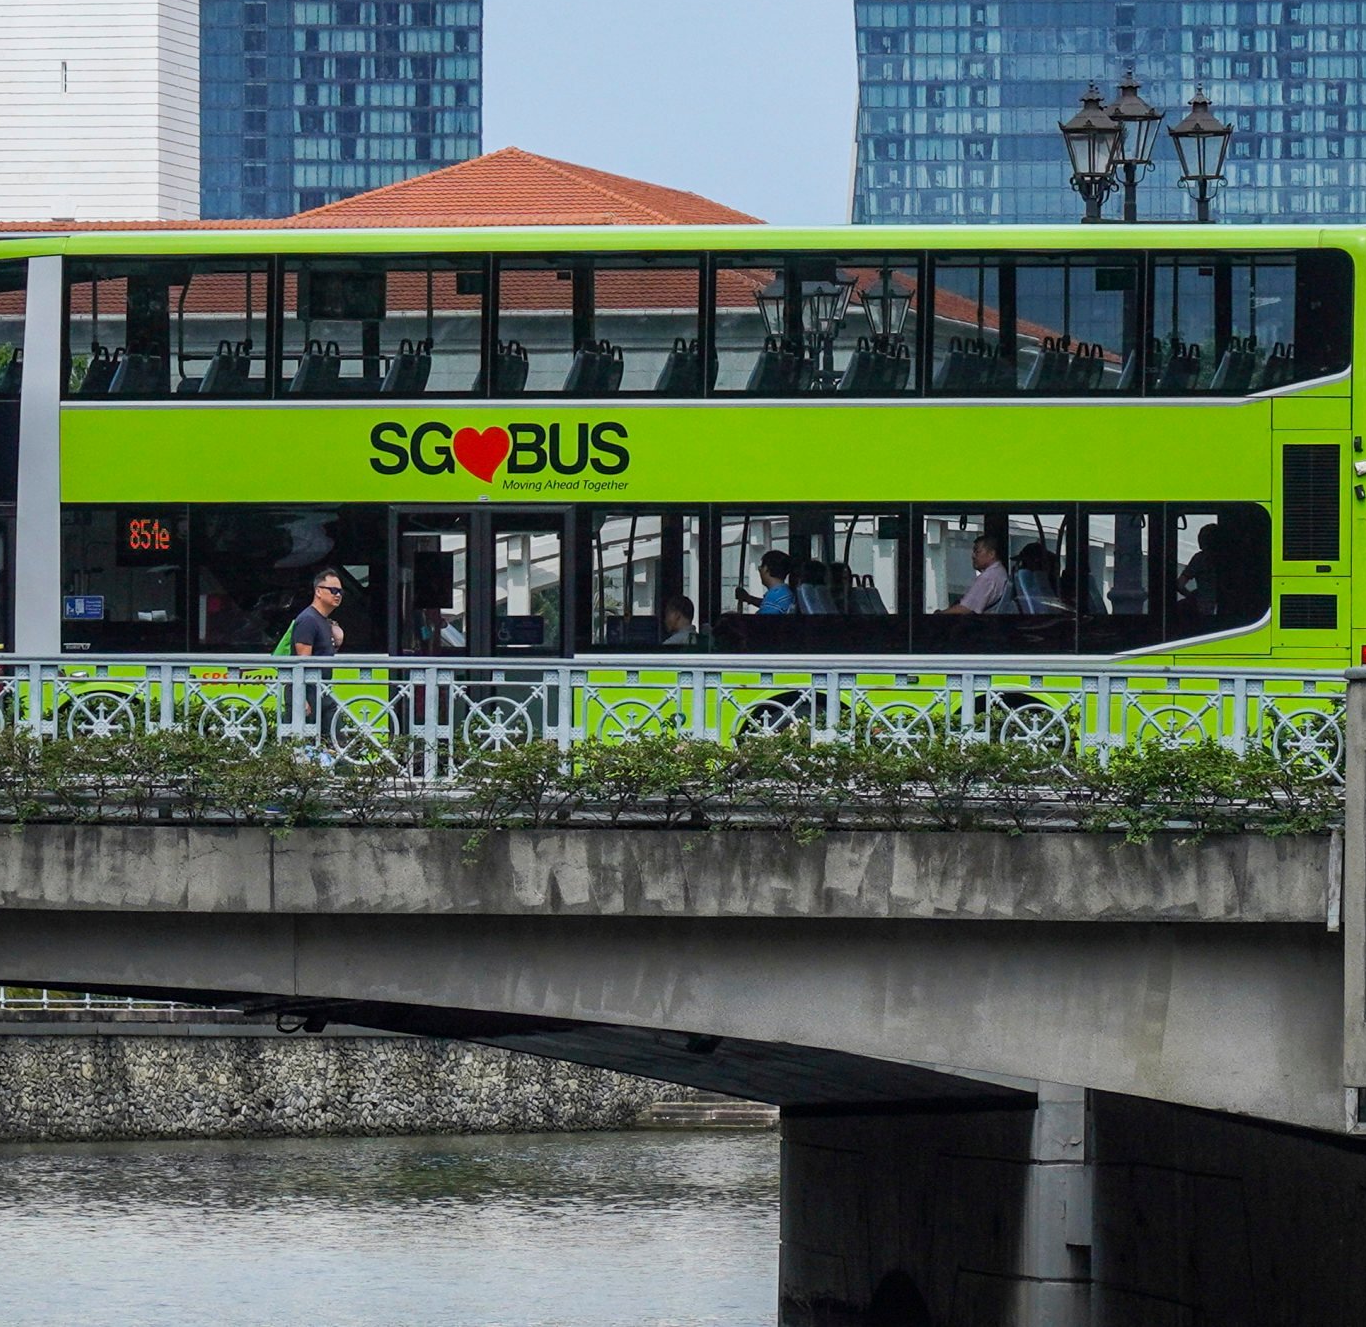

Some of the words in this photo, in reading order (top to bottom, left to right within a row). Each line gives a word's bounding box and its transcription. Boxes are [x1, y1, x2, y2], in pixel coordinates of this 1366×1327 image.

[502, 480, 542, 492] Moving
[544, 480, 580, 490] Ahead
[583, 480, 629, 492] Together
[129, 519, 170, 549] 851e
